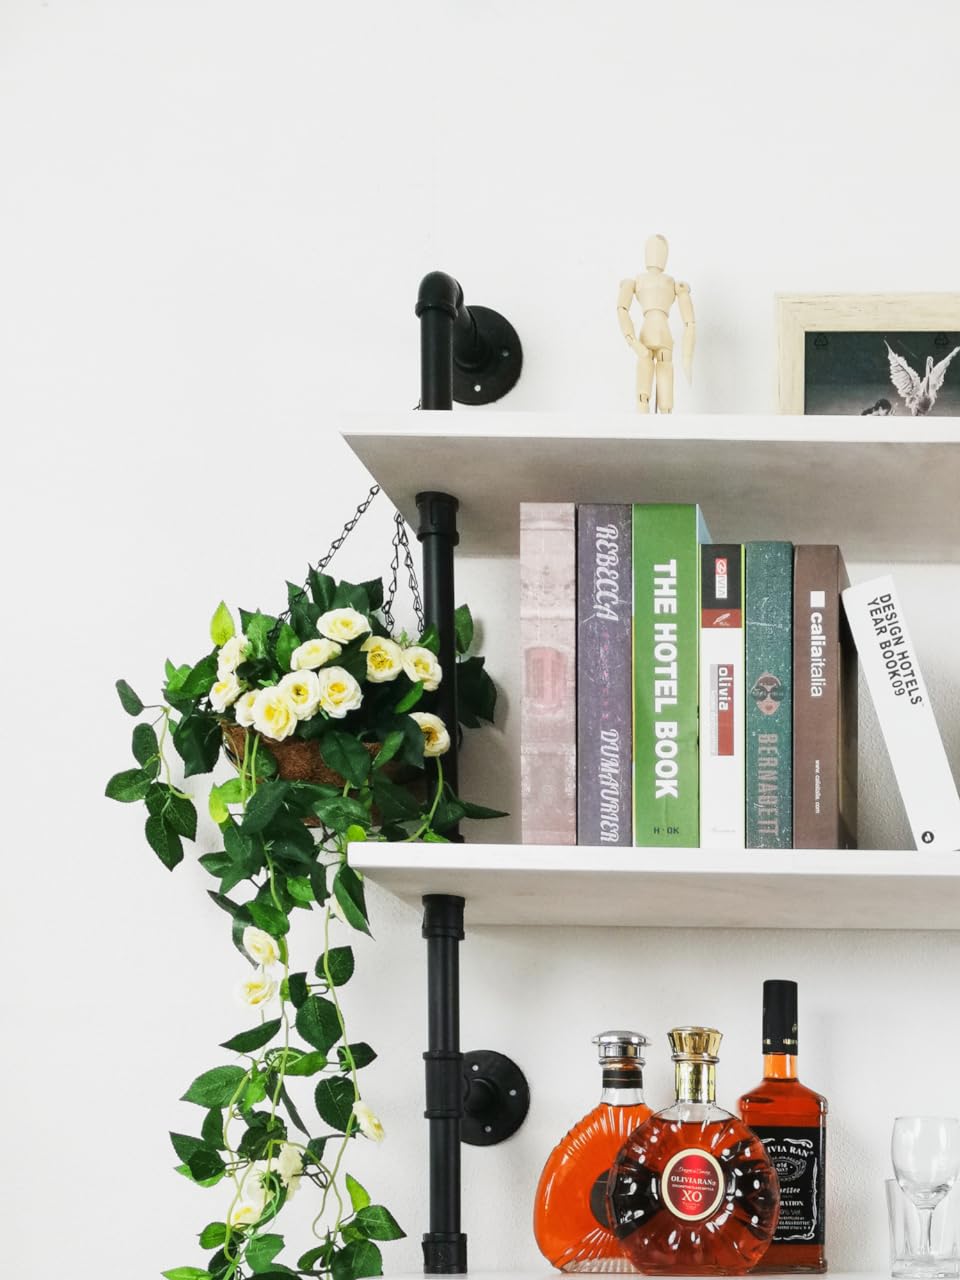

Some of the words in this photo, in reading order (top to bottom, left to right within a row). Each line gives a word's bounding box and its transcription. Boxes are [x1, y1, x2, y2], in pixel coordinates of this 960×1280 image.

[594, 524, 619, 621] REBECCA
[653, 559, 677, 615] THE
[810, 612, 826, 697] caliaitalia
[867, 597, 888, 636] YEAR
[879, 593, 905, 647] DESIGN
[896, 650, 923, 706] HOTELS
[653, 623, 679, 713] HOTEL
[718, 666, 732, 711] olivia
[654, 721, 679, 799] BOOK
[681, 1189, 703, 1203] XO
